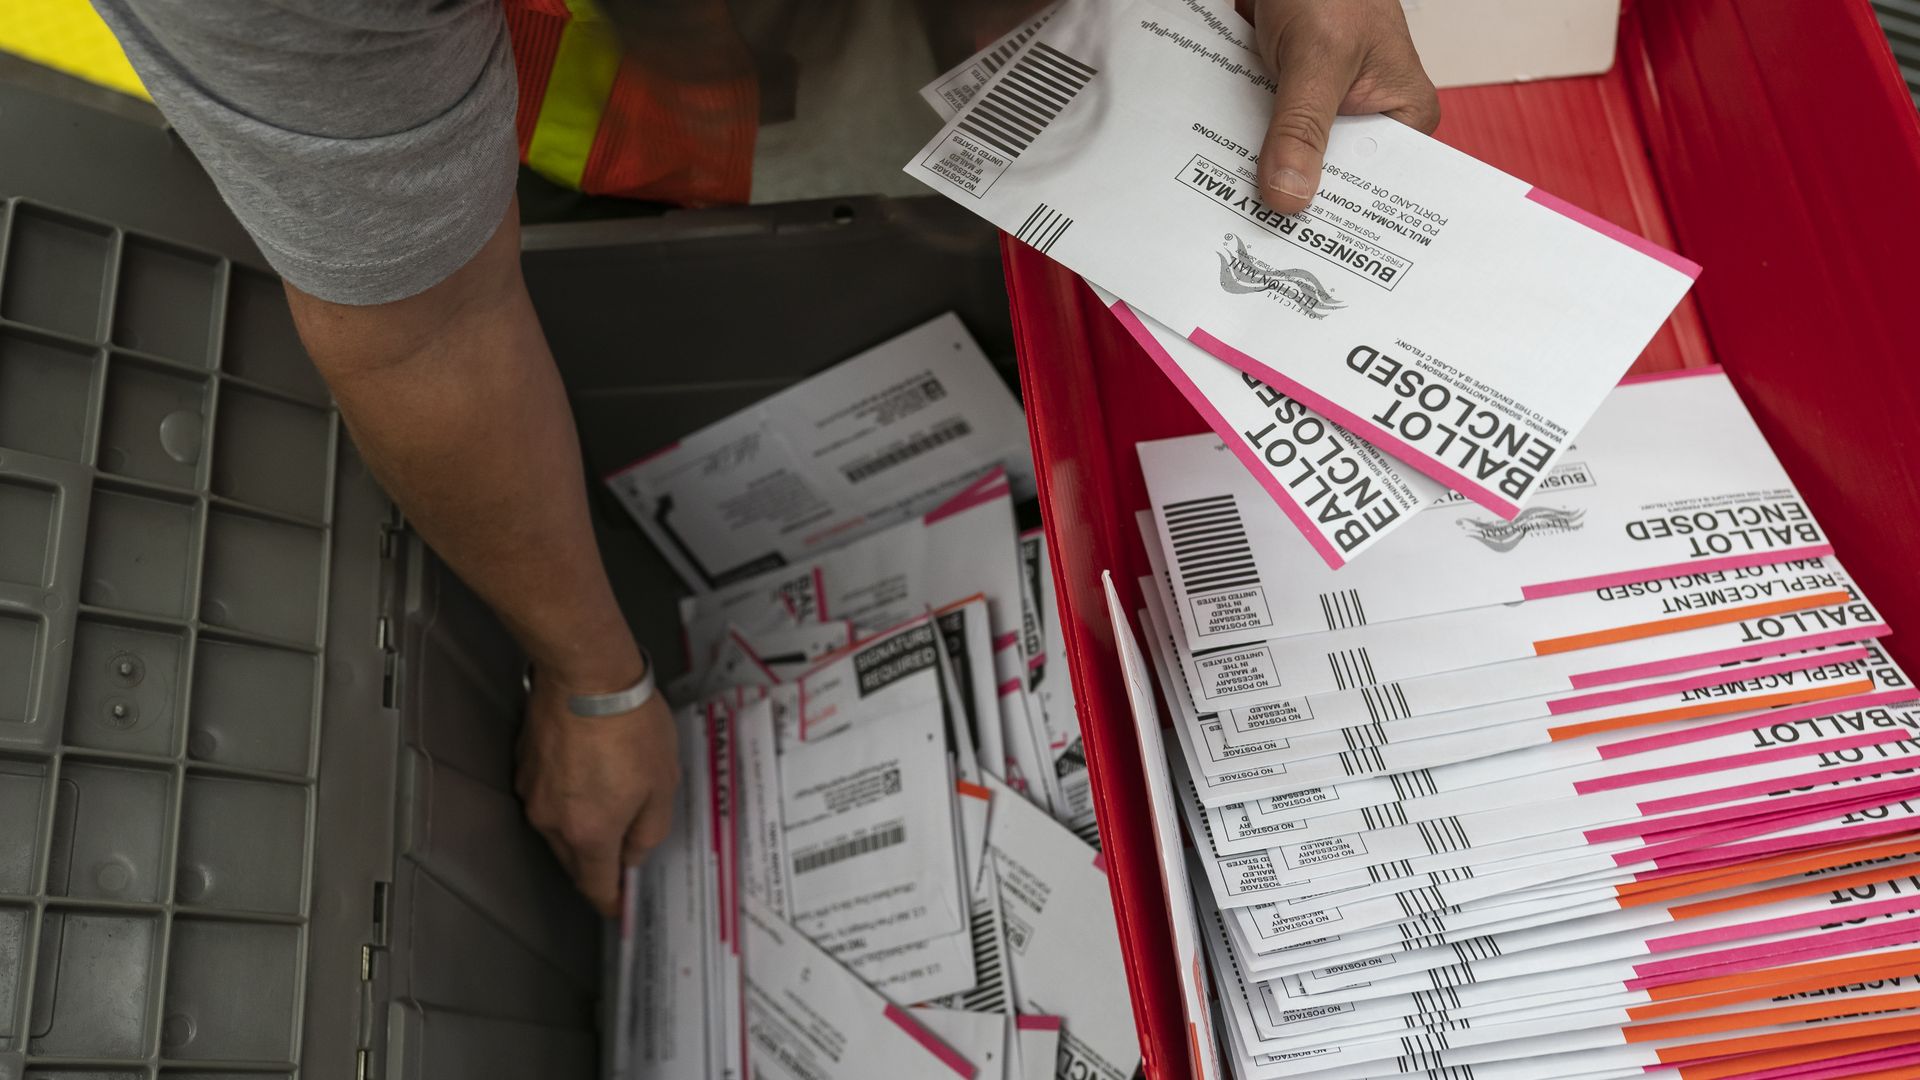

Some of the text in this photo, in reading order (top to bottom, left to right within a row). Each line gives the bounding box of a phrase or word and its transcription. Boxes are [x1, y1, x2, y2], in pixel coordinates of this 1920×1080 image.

[1192, 123, 1249, 157] ELECTIONS
[952, 136, 1004, 167] UNITED STATES
[960, 149, 975, 161] THE
[939, 158, 981, 184] NECESSARY
[949, 153, 976, 171] MAILED
[1196, 159, 1209, 169] OR
[932, 163, 977, 191] NO POSTAGE
[1192, 168, 1236, 201] MAIL
[1210, 167, 1237, 185] SALEM,
[1317, 189, 1362, 213] COUNTY
[1320, 161, 1448, 226] PORTLAND OR 97228-981
[1233, 196, 1298, 235] REPLY
[1292, 210, 1312, 224] PERM
[1312, 205, 1381, 241] POSTAGE WILL BE
[1372, 200, 1439, 236] PO BOX 5500
[1361, 209, 1432, 246] MULTNOMAH
[1336, 231, 1354, 244] MAIL
[1298, 228, 1397, 283] BUSINESS
[1353, 240, 1404, 269] FIRST-CLASS
[1226, 255, 1319, 311] ELECTION MAIL
[1264, 289, 1317, 321] OFFICIAL
[1395, 340, 1426, 358] FELONY.
[1432, 358, 1458, 375] CLASS
[1415, 360, 1562, 444] WARNING: SIGNING ANOTHER PERSON'S
[1473, 380, 1514, 406] ENVELOPE
[1346, 345, 1556, 472] ENCLOSED
[1514, 402, 1532, 416] THIS
[1532, 413, 1544, 423] TO
[1545, 420, 1568, 436] NAME
[1372, 399, 1535, 500] BALLOT
[1356, 447, 1383, 477] SIGNING
[1376, 456, 1394, 475] THIS
[1389, 472, 1402, 485] TO
[1536, 471, 1587, 490] BUSI
[1245, 427, 1370, 555] BALLOT
[1378, 474, 1412, 512] WARNING:
[1398, 482, 1420, 505] NAME
[1625, 502, 1807, 541] ENCLOSED
[1690, 522, 1821, 558] BALLOT
[1596, 557, 1824, 601] BALLOT ENCLOSED
[1197, 591, 1257, 605] UNITED STATES
[1662, 573, 1837, 613] REPLACEMENT
[1209, 612, 1257, 624] NECESSARY
[1211, 608, 1241, 617] MAILED
[1739, 601, 1877, 642] BALLOT
[1209, 621, 1247, 632] POSTAGE
[856, 624, 935, 670] SIGNATURE
[860, 645, 938, 688] REQUIRED
[1202, 651, 1264, 667] UNITED STATES
[1216, 673, 1264, 686] NECESSARY
[1218, 668, 1248, 679] MAILED
[1681, 660, 1861, 702] REPLACEMENT
[1216, 682, 1254, 694] POSTAGE
[1248, 707, 1297, 721] NECESSARY
[1249, 703, 1281, 713] MAILED
[1247, 713, 1301, 728] NO POSTAGE
[1752, 709, 1897, 748] BALLOT
[1222, 745, 1262, 757] POSTAGE
[1219, 770, 1259, 782] POSTAGE
[1271, 796, 1312, 809] POSTAGE
[1272, 787, 1321, 802] NECESSARY
[1239, 824, 1279, 837] POSTAGE
[1299, 843, 1350, 858] NECESSARY
[1300, 840, 1333, 851] MAILED
[1226, 858, 1256, 867] STATES
[1298, 852, 1340, 865] POSTAGE
[1240, 874, 1277, 885] ESSARY
[1272, 910, 1324, 926] NECESSARY
[1272, 919, 1314, 933] POSTAGE
[1325, 961, 1367, 974] POSTAGE
[1283, 1008, 1326, 1022] POSTAGE
